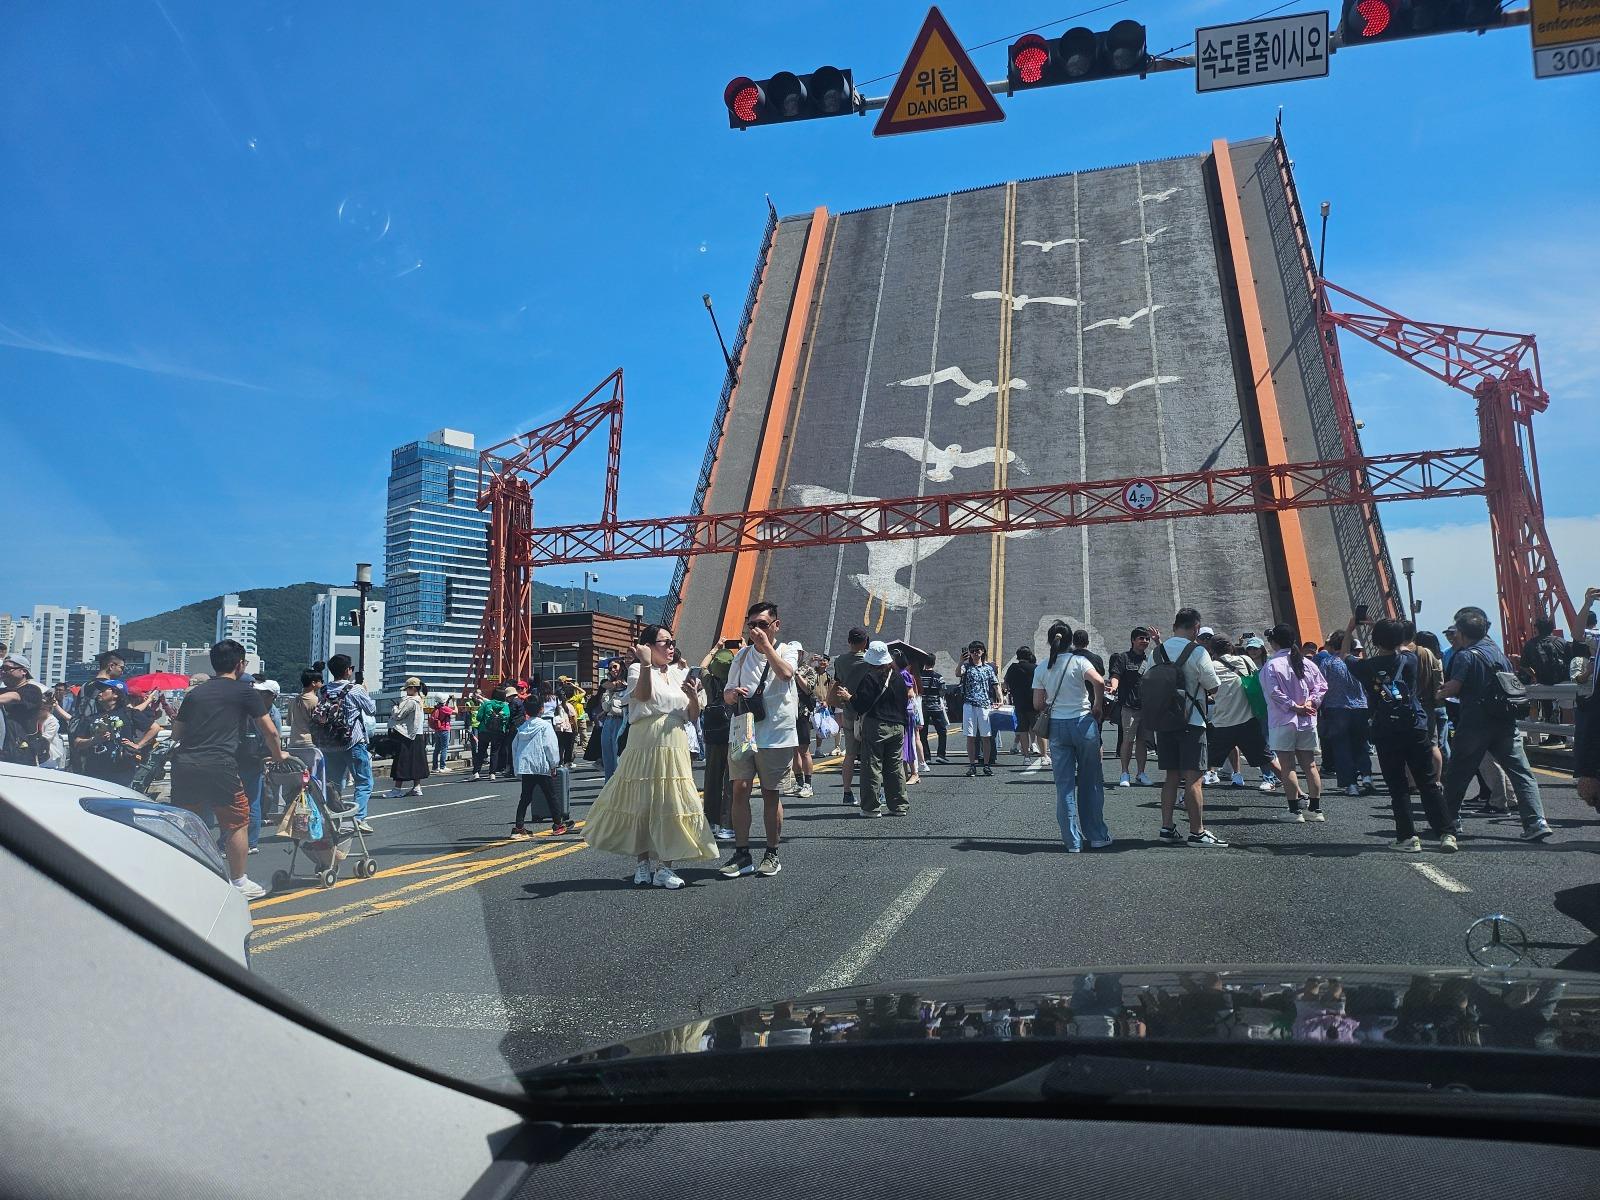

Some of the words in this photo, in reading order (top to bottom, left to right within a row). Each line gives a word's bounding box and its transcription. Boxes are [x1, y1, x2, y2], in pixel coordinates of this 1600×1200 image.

[1201, 26, 1323, 79] 속도를줄이시오
[1552, 47, 1600, 71] 300
[916, 65, 958, 95] 위험
[907, 95, 968, 116] DANGER
